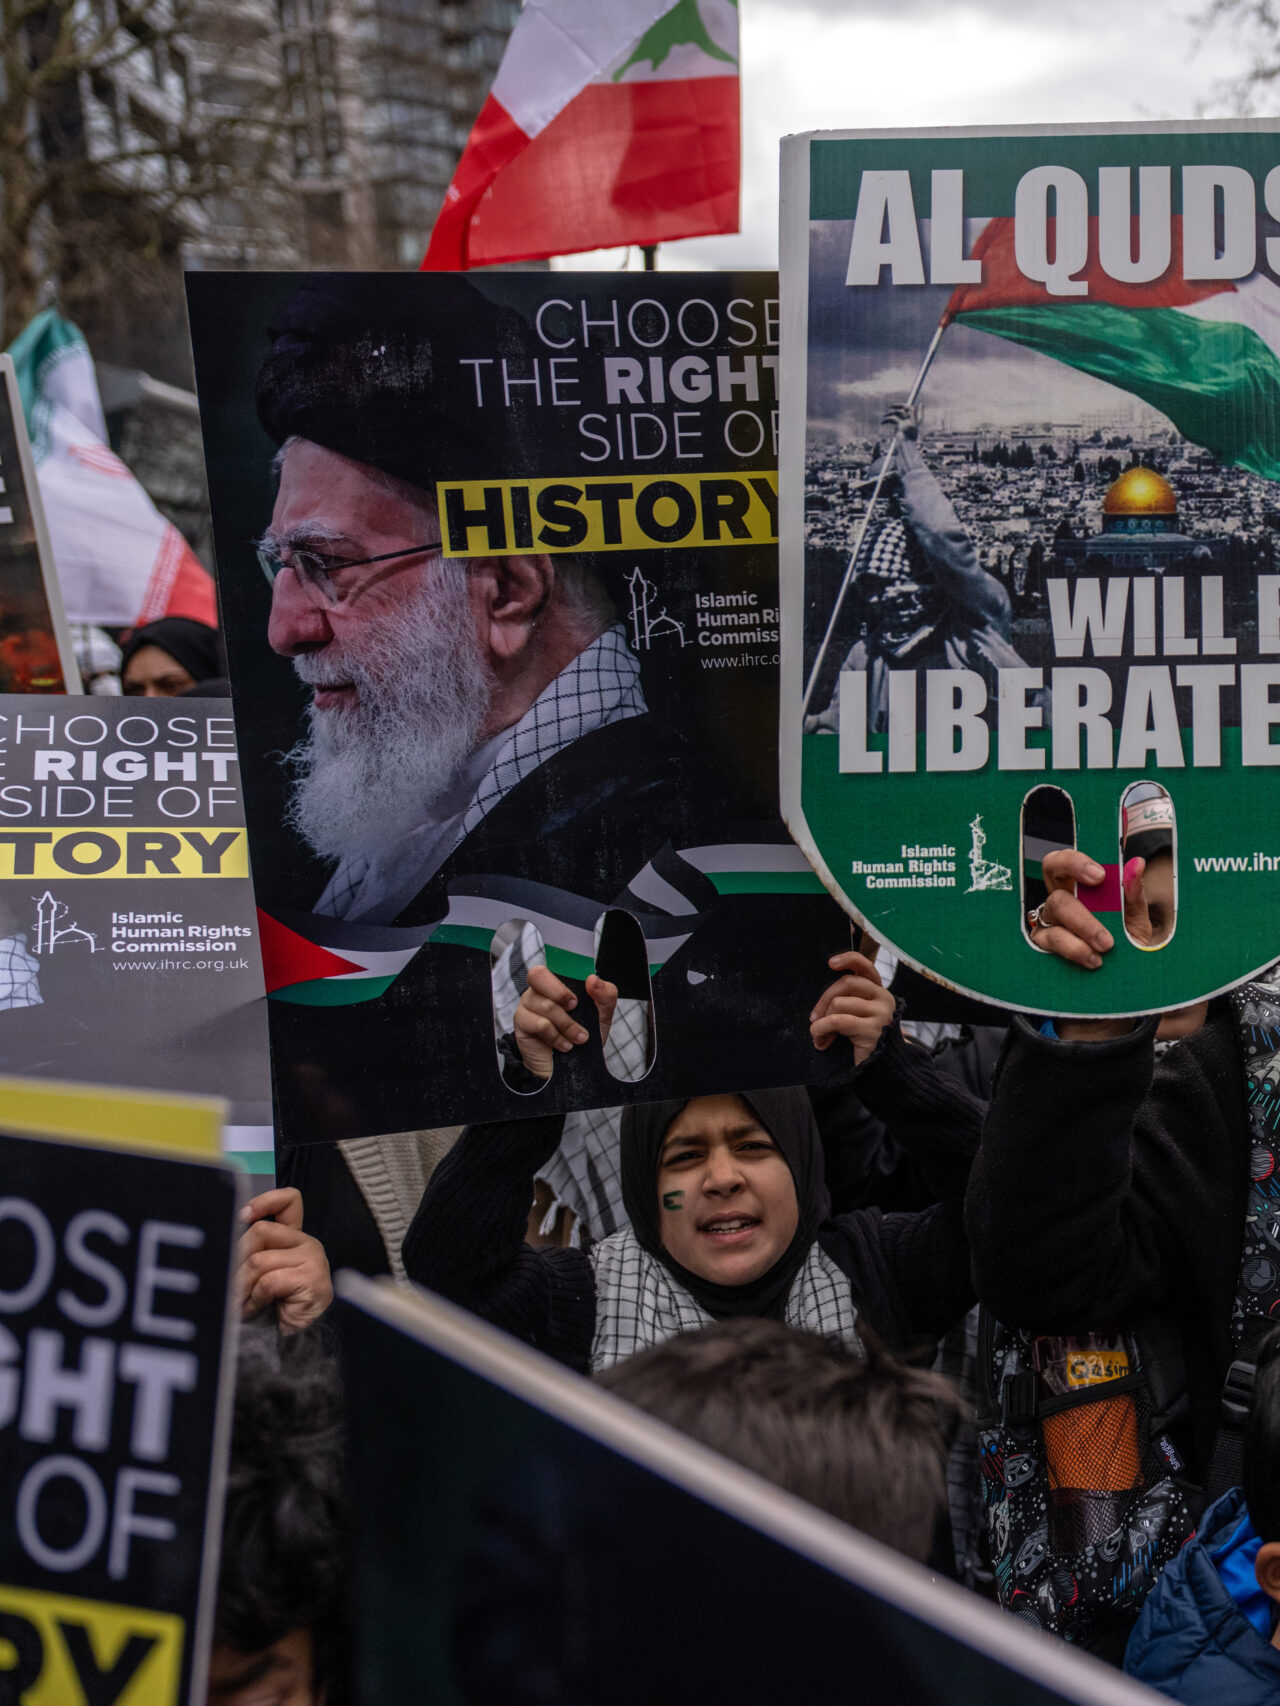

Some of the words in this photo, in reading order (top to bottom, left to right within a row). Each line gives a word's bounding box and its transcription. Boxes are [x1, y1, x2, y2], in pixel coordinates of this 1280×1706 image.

[845, 168, 982, 286] AL
[459, 357, 582, 407] THE
[579, 411, 703, 462] SIDE
[695, 590, 759, 609] Islamic
[696, 611, 760, 628] Human
[1046, 575, 1238, 658] WILL
[33, 750, 238, 782] RIGHT
[0, 785, 134, 818] SIDE
[156, 786, 237, 819] OF
[900, 843, 956, 858] Islamic
[851, 860, 904, 875] Human
[908, 859, 956, 876] Rights
[865, 873, 956, 889] Commission
[112, 911, 184, 925] Islamic
[111, 926, 185, 939] Human
[188, 925, 252, 940] Rights
[111, 939, 237, 953] Commission
[112, 958, 249, 972] www.ihrc.org.uk
[16, 1453, 182, 1581] OF
